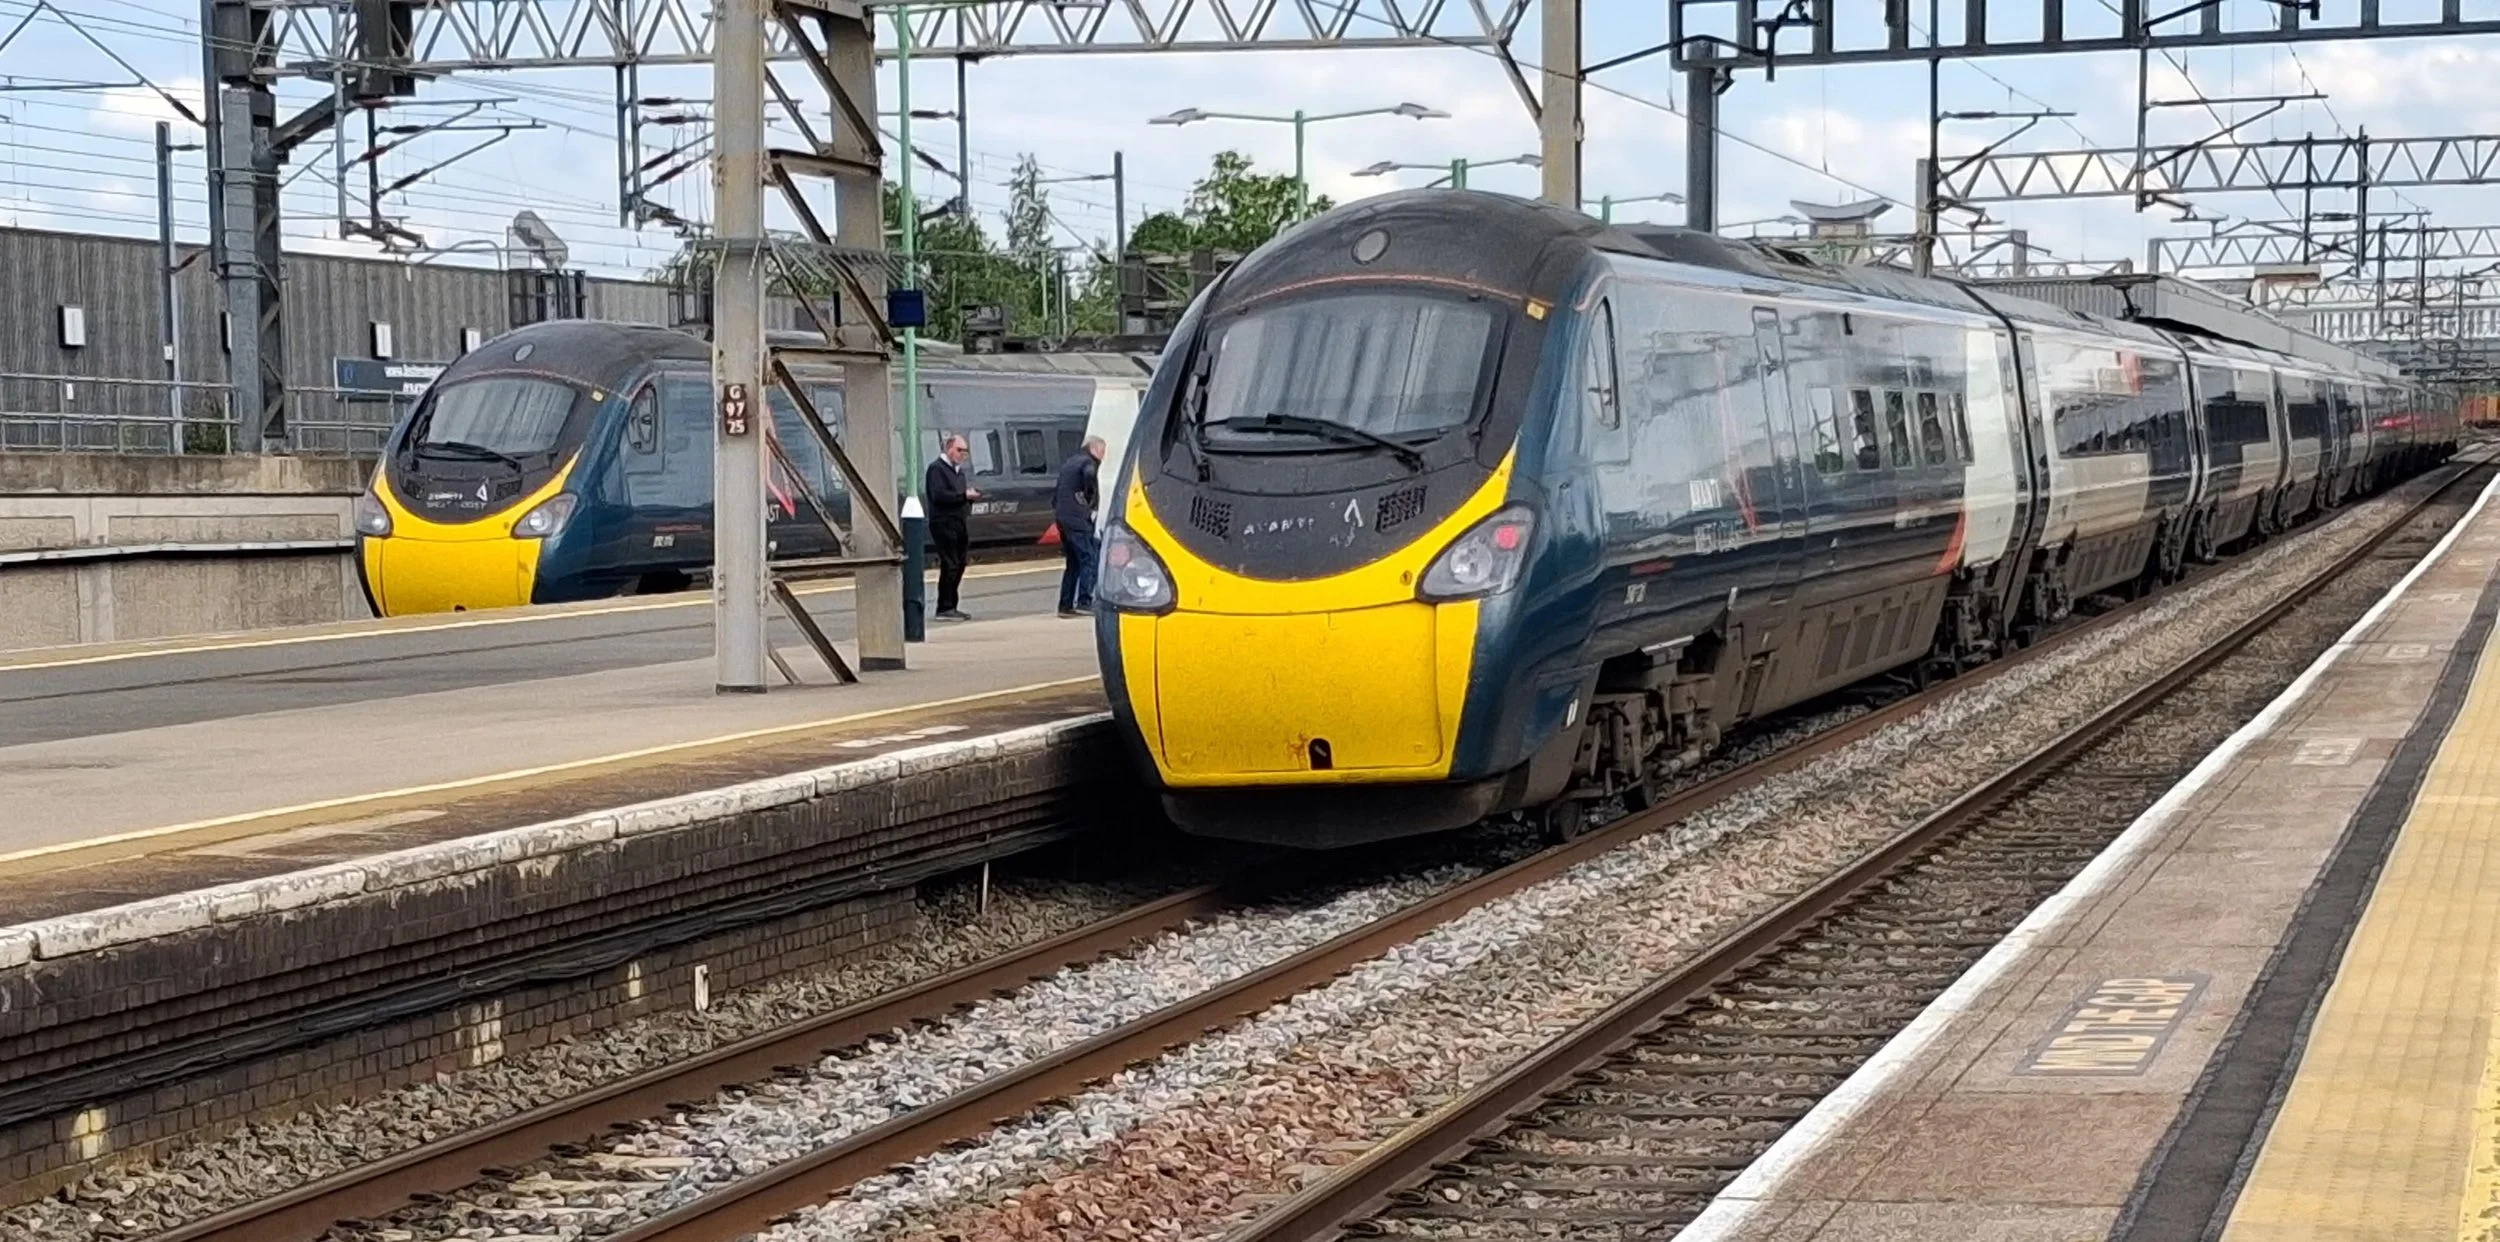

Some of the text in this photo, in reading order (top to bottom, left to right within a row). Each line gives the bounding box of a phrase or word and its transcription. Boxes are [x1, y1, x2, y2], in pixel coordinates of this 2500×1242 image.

[729, 385, 742, 399] G
[726, 402, 746, 417] 97
[727, 420, 746, 434] 25
[2087, 978, 2196, 1005] GAP
[2063, 1008, 2179, 1033] THE
